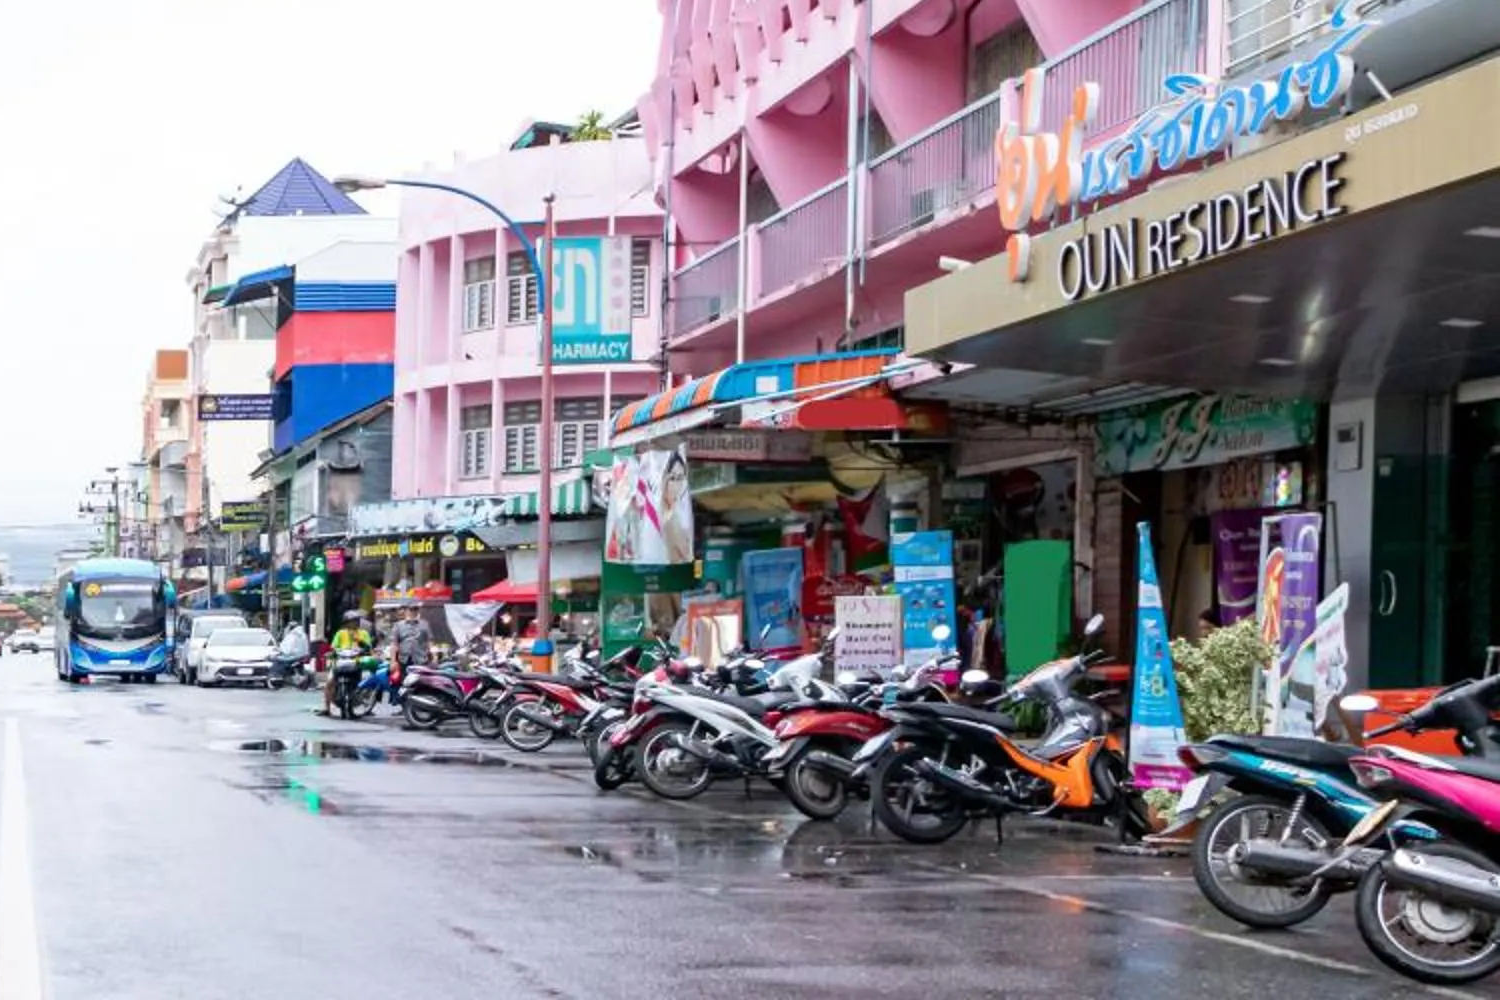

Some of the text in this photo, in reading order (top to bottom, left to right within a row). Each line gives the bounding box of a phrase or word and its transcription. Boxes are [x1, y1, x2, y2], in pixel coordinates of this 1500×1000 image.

[996, 68, 1100, 283] อุ่น
[1057, 150, 1349, 302] OUN RESIDENCE
[552, 340, 629, 359] HARMACY
